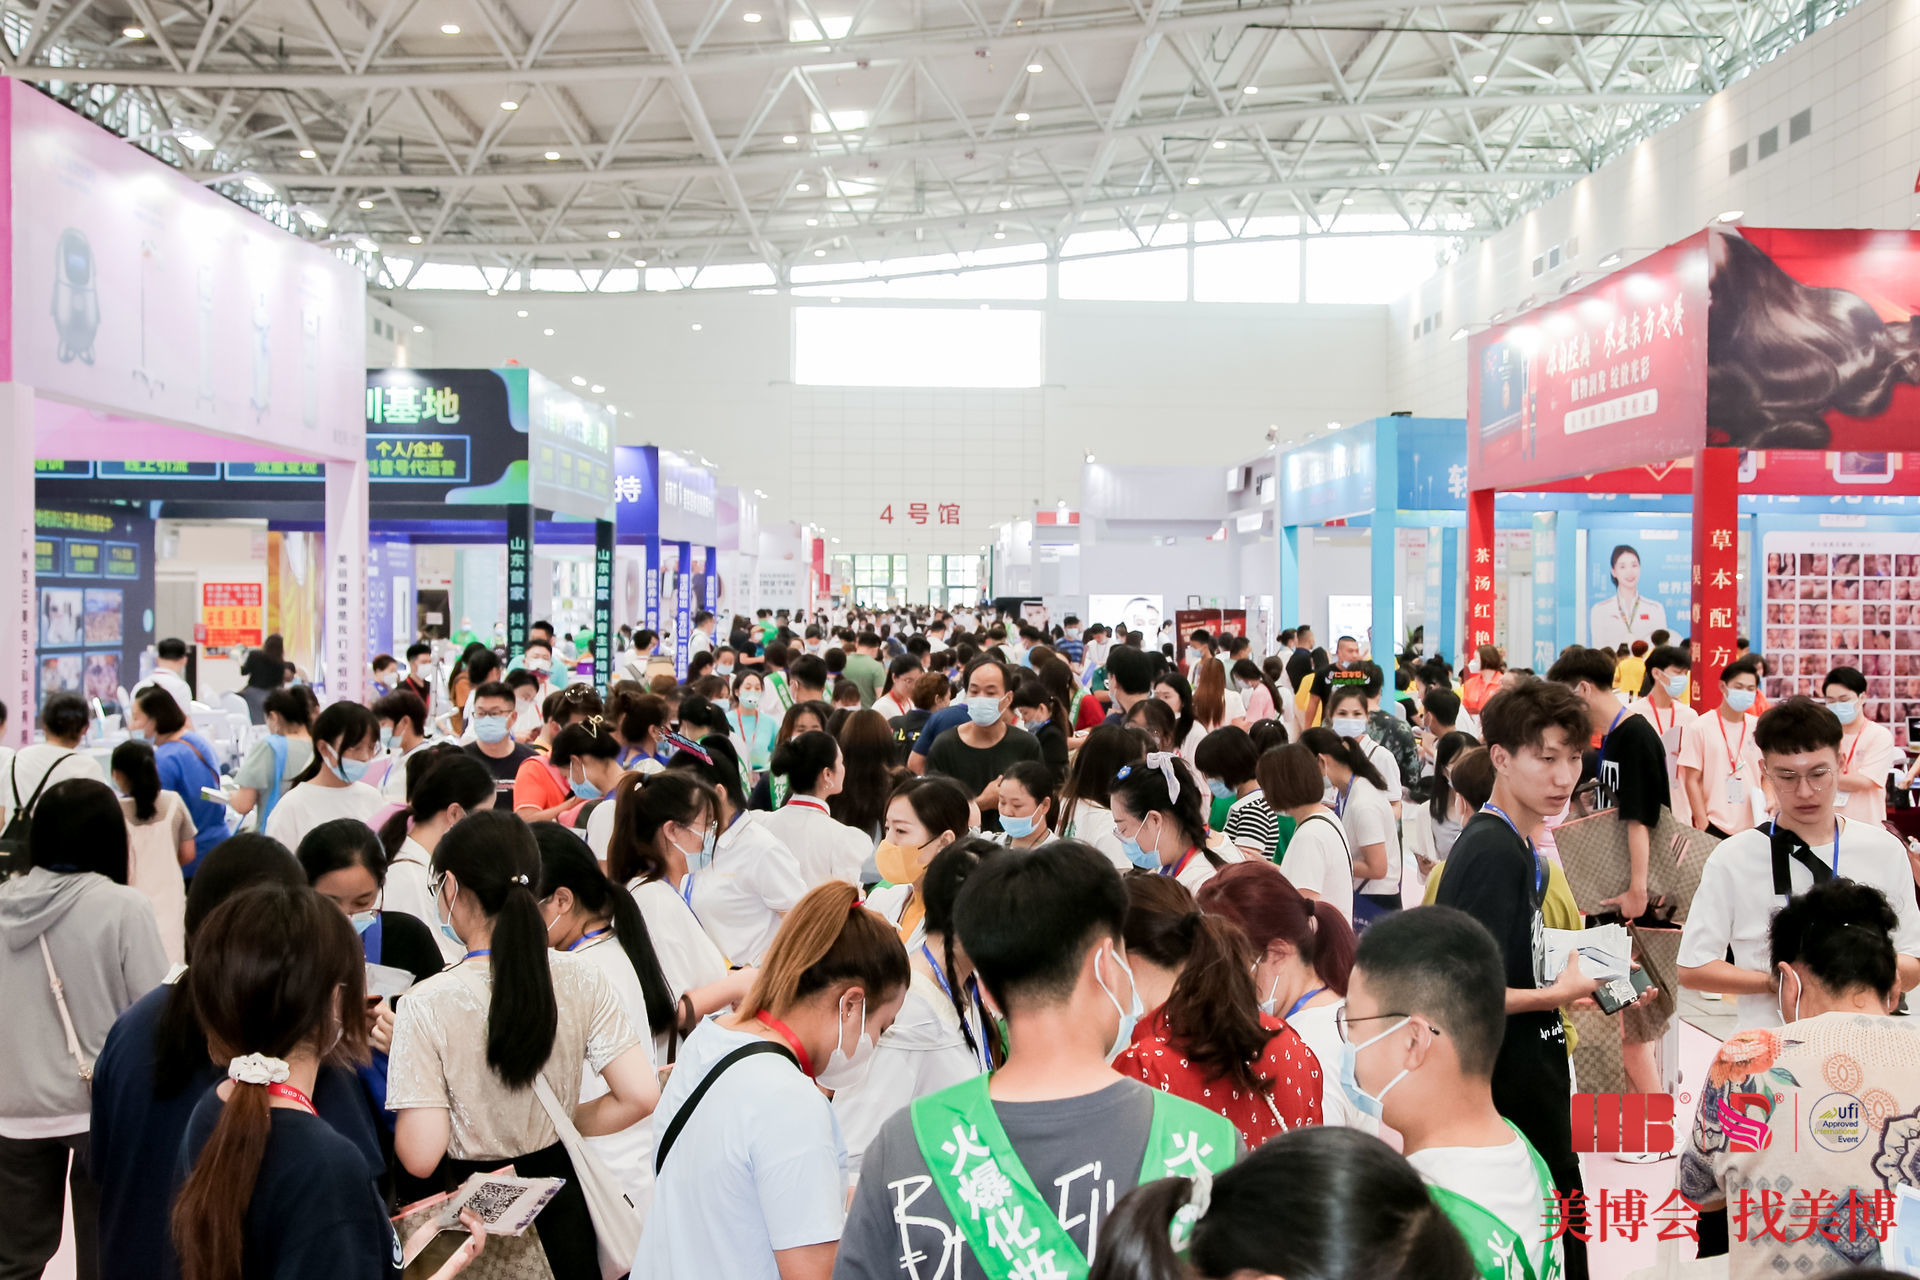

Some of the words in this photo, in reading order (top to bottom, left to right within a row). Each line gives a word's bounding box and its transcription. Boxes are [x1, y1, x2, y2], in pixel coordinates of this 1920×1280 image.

[376, 440, 444, 459] 个人/企业
[614, 475, 642, 502] 持
[879, 503, 961, 525] 4号馆
[509, 536, 526, 601] 山东首家
[596, 548, 610, 600] 山东首家
[1474, 547, 1491, 646] 茶汤红艳
[1710, 529, 1733, 668] 草本配方
